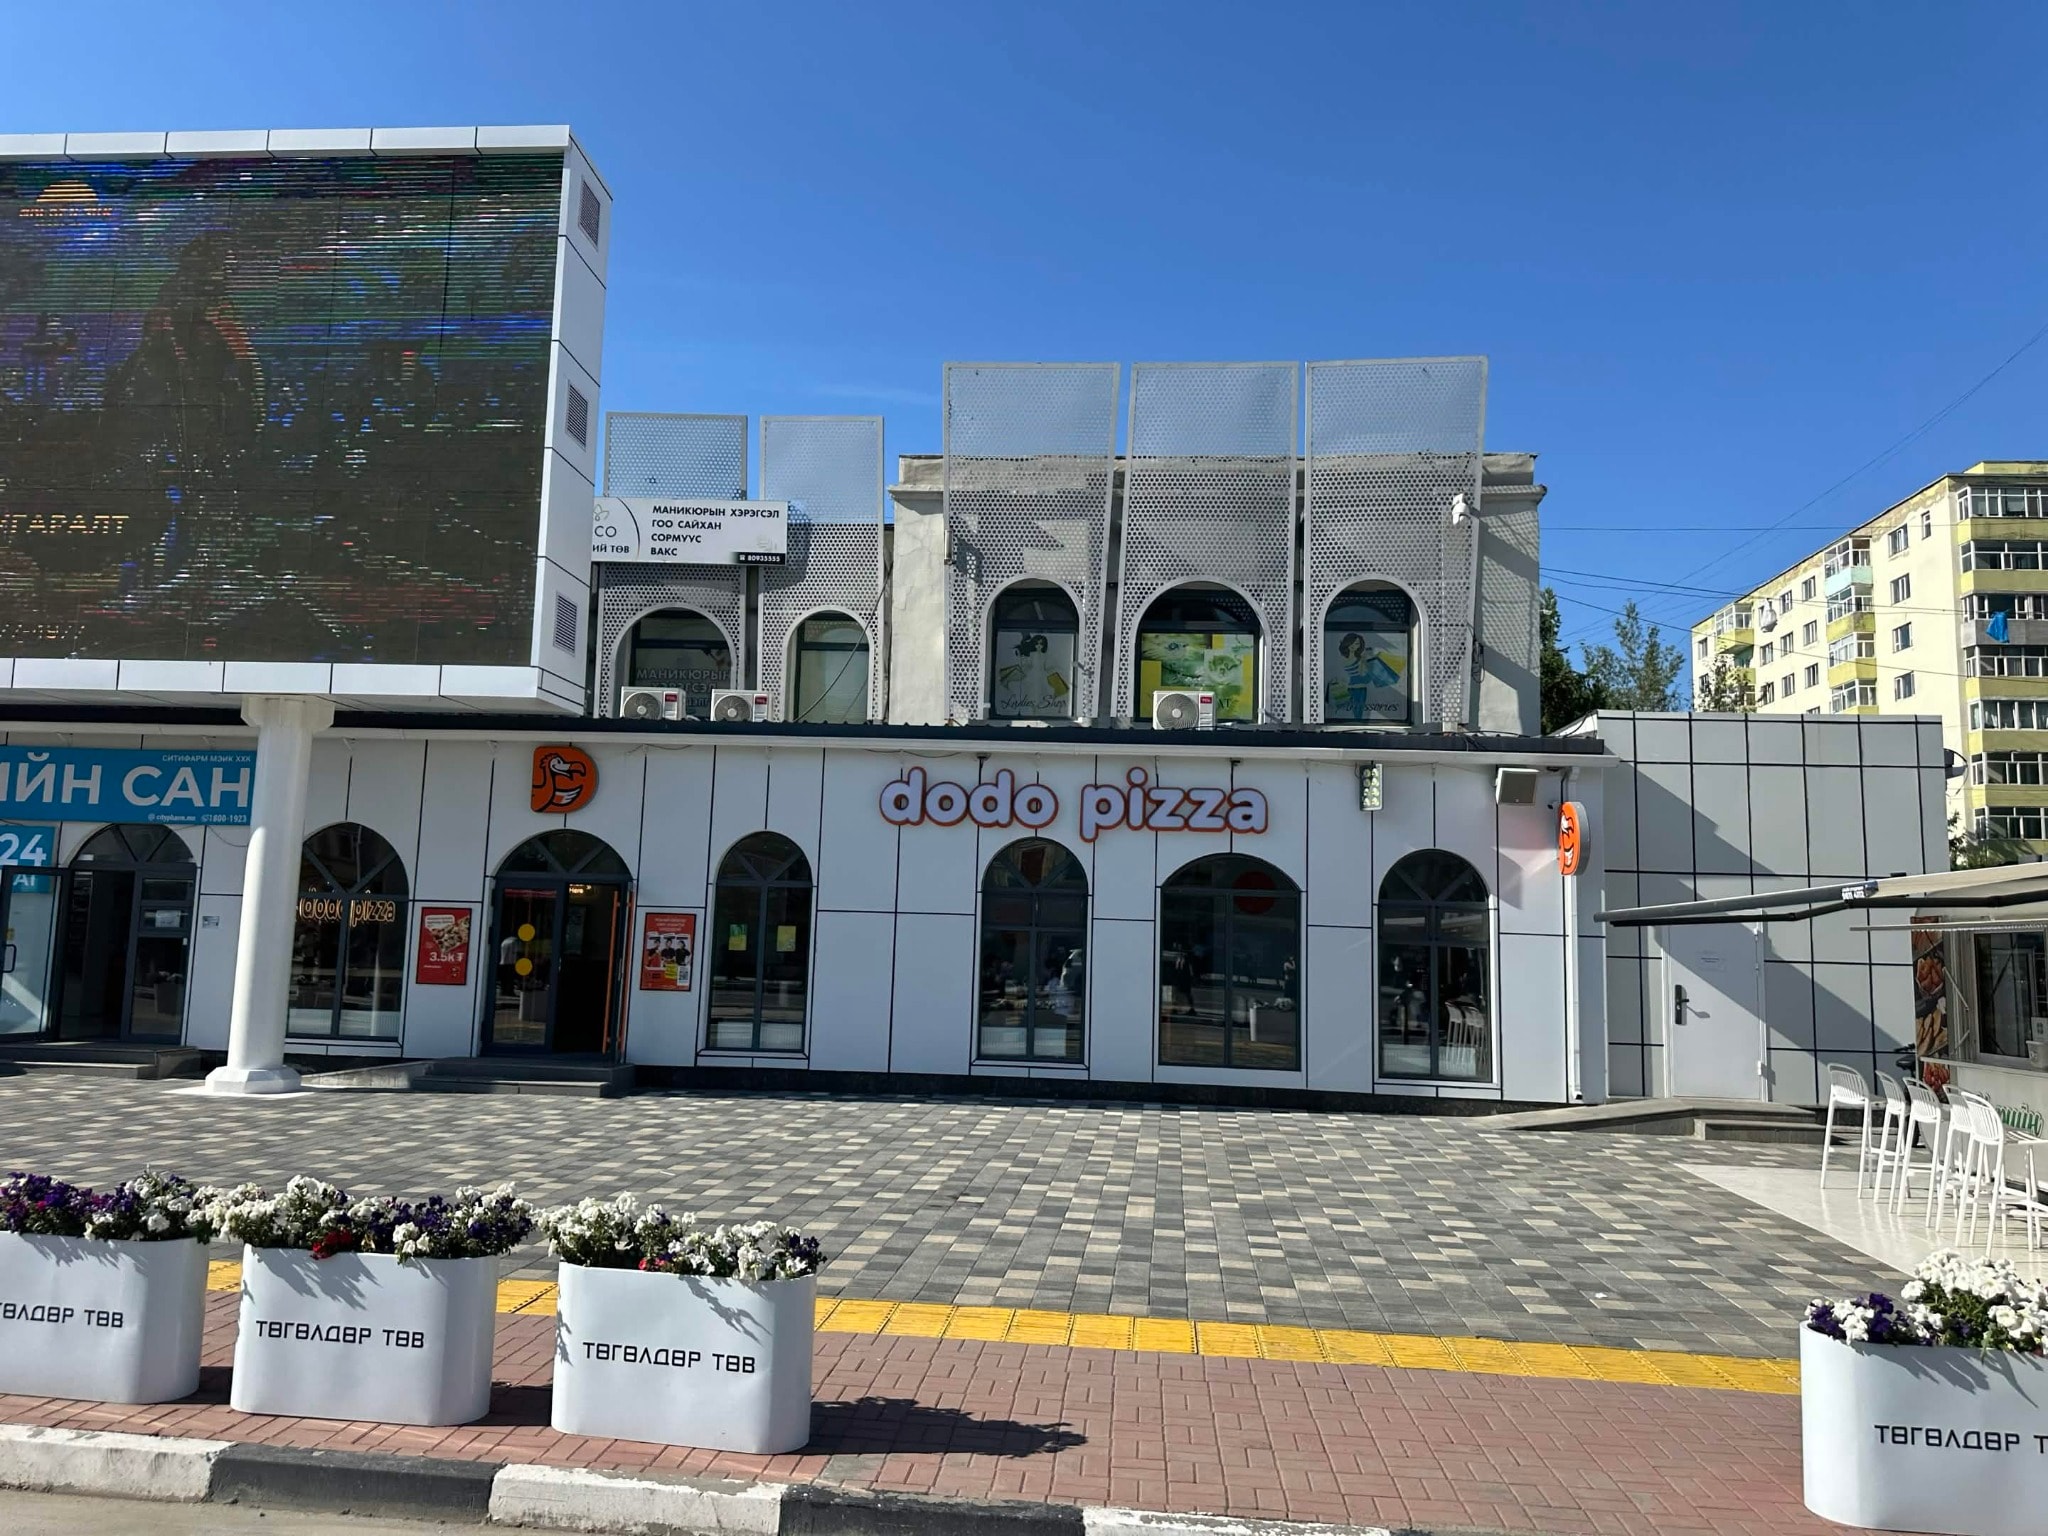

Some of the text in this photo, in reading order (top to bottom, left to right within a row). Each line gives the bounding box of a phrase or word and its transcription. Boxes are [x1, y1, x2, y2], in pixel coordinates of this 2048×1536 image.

[652, 519, 722, 530] ГОО САЙХАН
[653, 505, 780, 518] МАНИКЮРЫН ХЭРЭГСЭЛ
[610, 545, 630, 553] ТӨВ
[652, 533, 702, 543] СОРМУУС
[651, 547, 678, 556] ВАКС
[122, 765, 250, 807] САН
[879, 766, 1269, 843] dodo pizza
[0, 1302, 124, 1328] ӨЛДӨР ТӨВ
[256, 1320, 425, 1348] ТӨГӨЛДӨР ТӨВ
[583, 1342, 755, 1373] ТӨГӨЛДӨР ТӨВ
[1874, 1425, 2020, 1451] ТӨГӨЛДӨР
